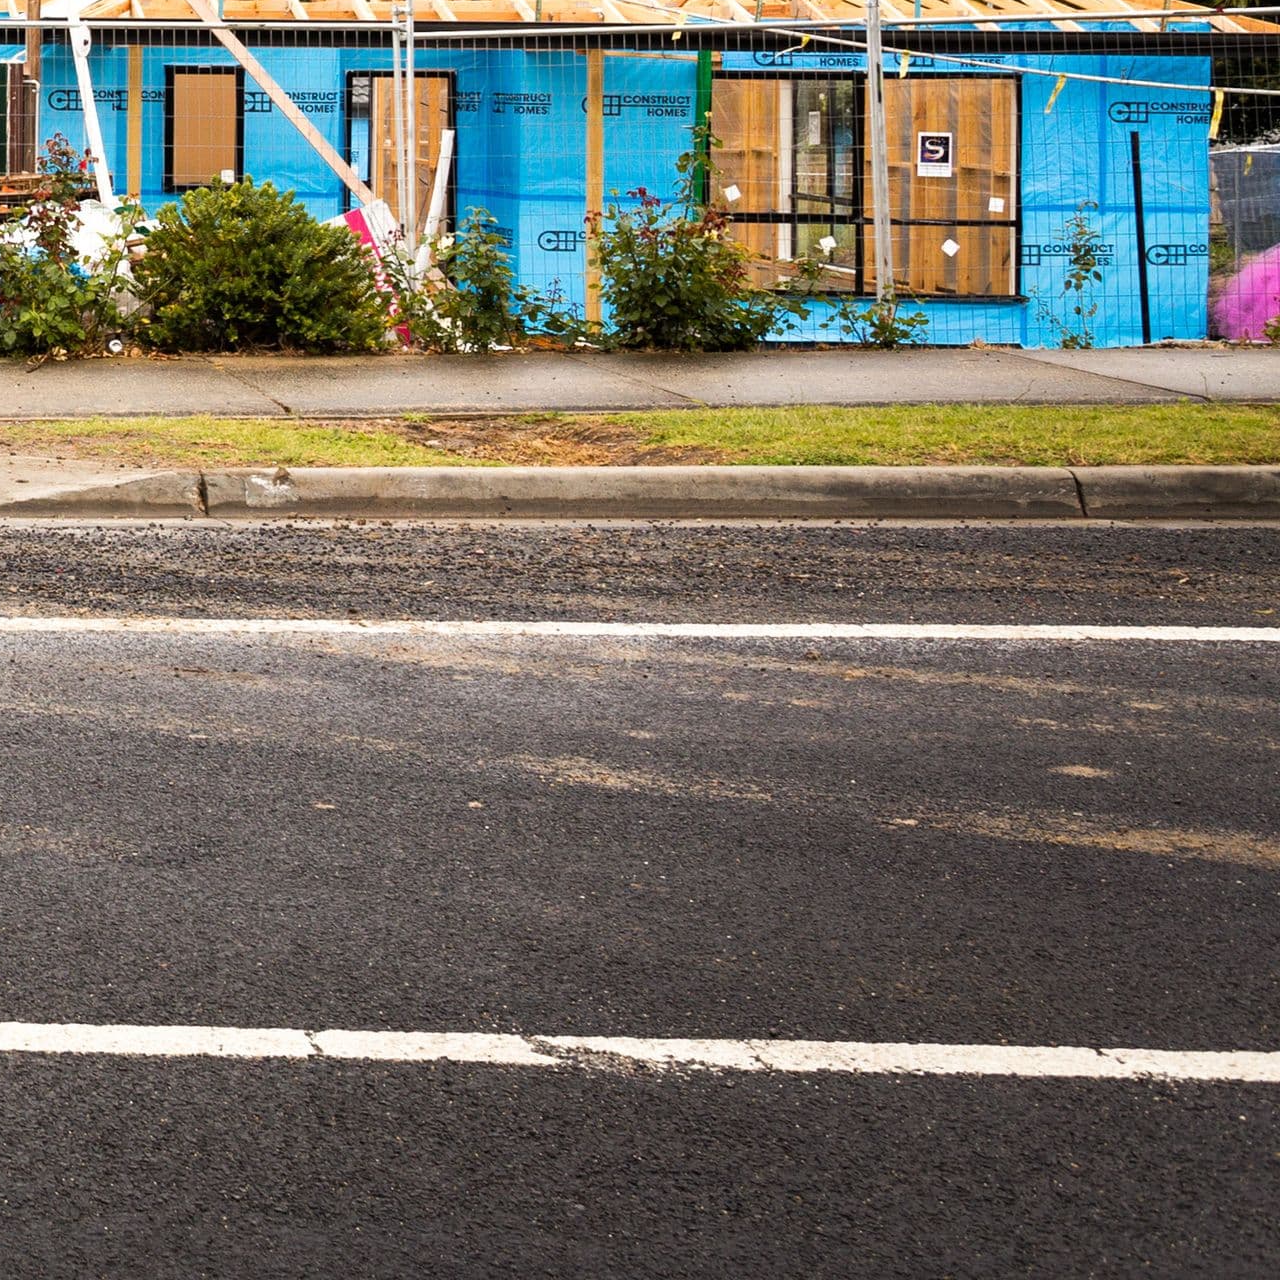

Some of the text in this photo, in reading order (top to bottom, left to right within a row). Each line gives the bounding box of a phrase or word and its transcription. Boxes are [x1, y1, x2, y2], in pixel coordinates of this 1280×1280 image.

[819, 57, 859, 67] HOMES
[623, 95, 691, 105] CONSTRUCT
[1150, 102, 1211, 111] CONSTRUC
[646, 107, 688, 117] HOMES
[1176, 115, 1210, 124] HOME
